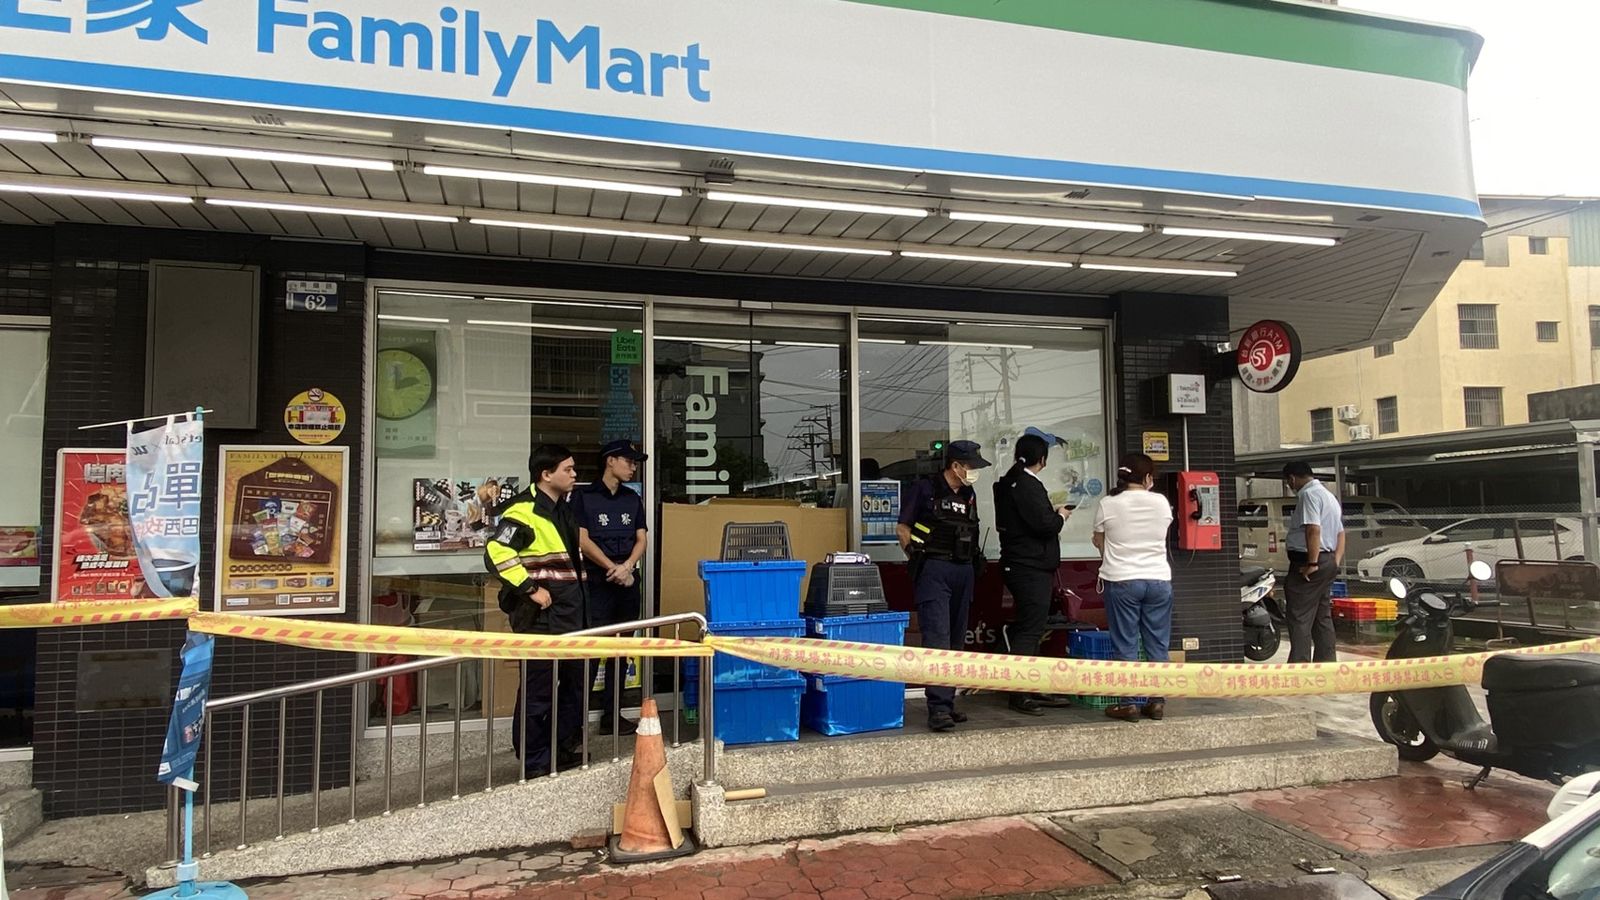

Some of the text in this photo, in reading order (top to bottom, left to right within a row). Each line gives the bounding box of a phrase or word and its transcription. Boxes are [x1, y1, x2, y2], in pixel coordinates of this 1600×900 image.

[257, 0, 711, 102] FamilyMart
[305, 295, 326, 310] 62
[616, 336, 635, 344] Uber
[616, 344, 636, 352] Eats
[685, 366, 729, 494] Famil
[598, 512, 631, 526] 警察
[965, 621, 996, 645] et's
